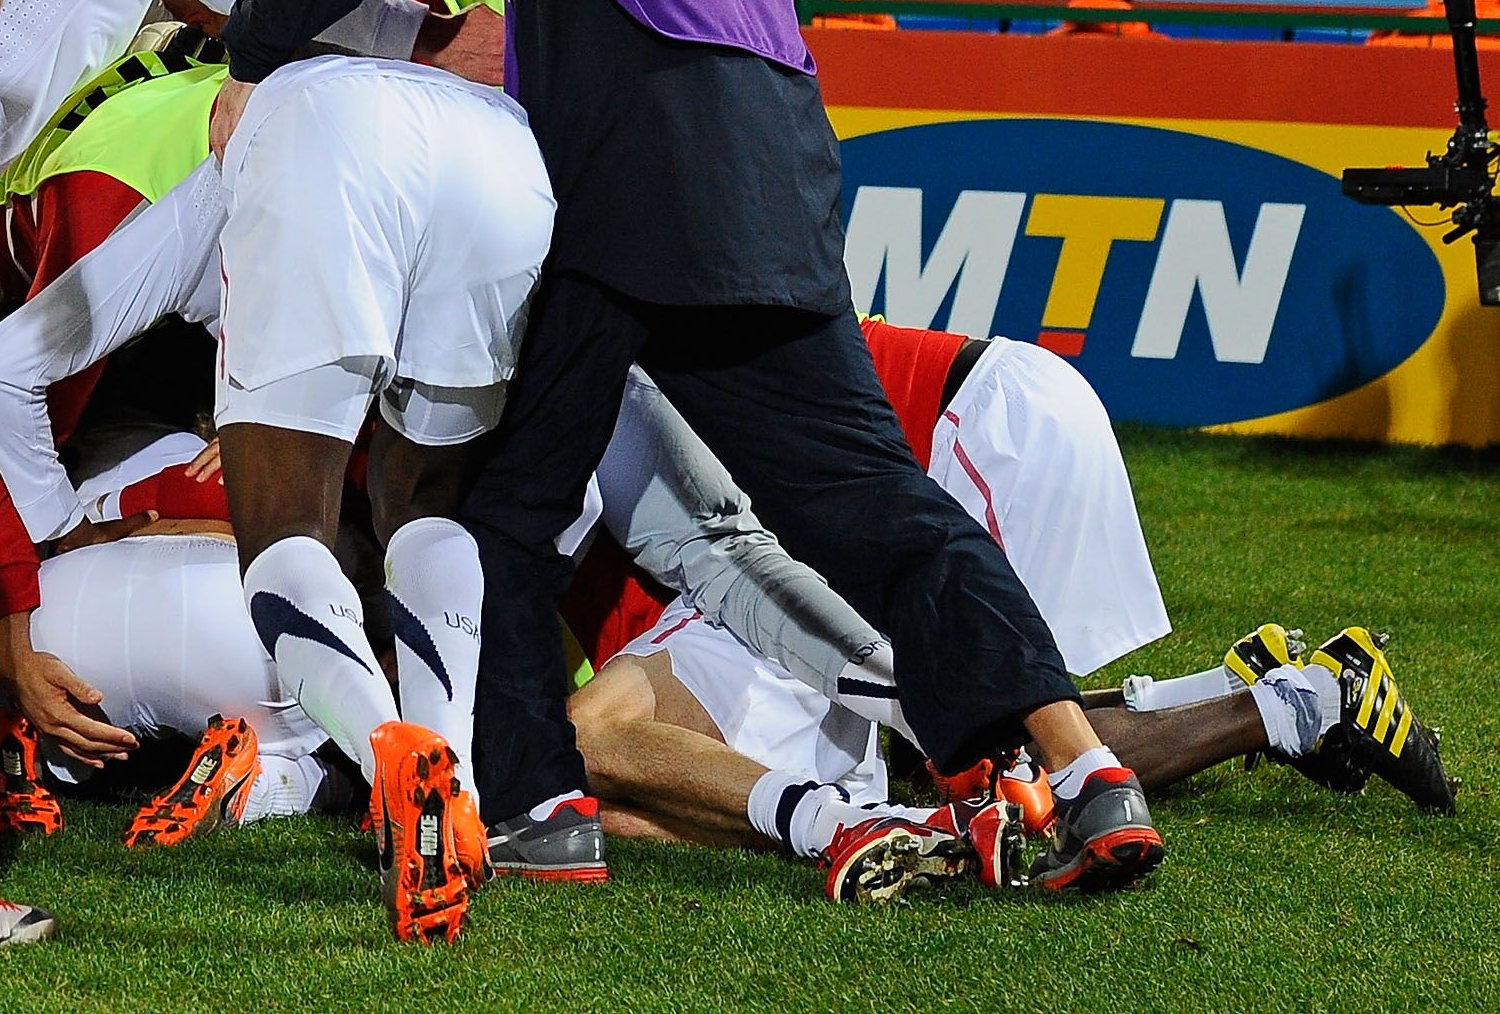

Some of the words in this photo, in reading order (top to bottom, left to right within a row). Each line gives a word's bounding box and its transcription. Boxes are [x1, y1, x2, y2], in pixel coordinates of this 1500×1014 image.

[844, 186, 1307, 364] MTN
[329, 603, 364, 629] US
[420, 814, 438, 856] NIKE
